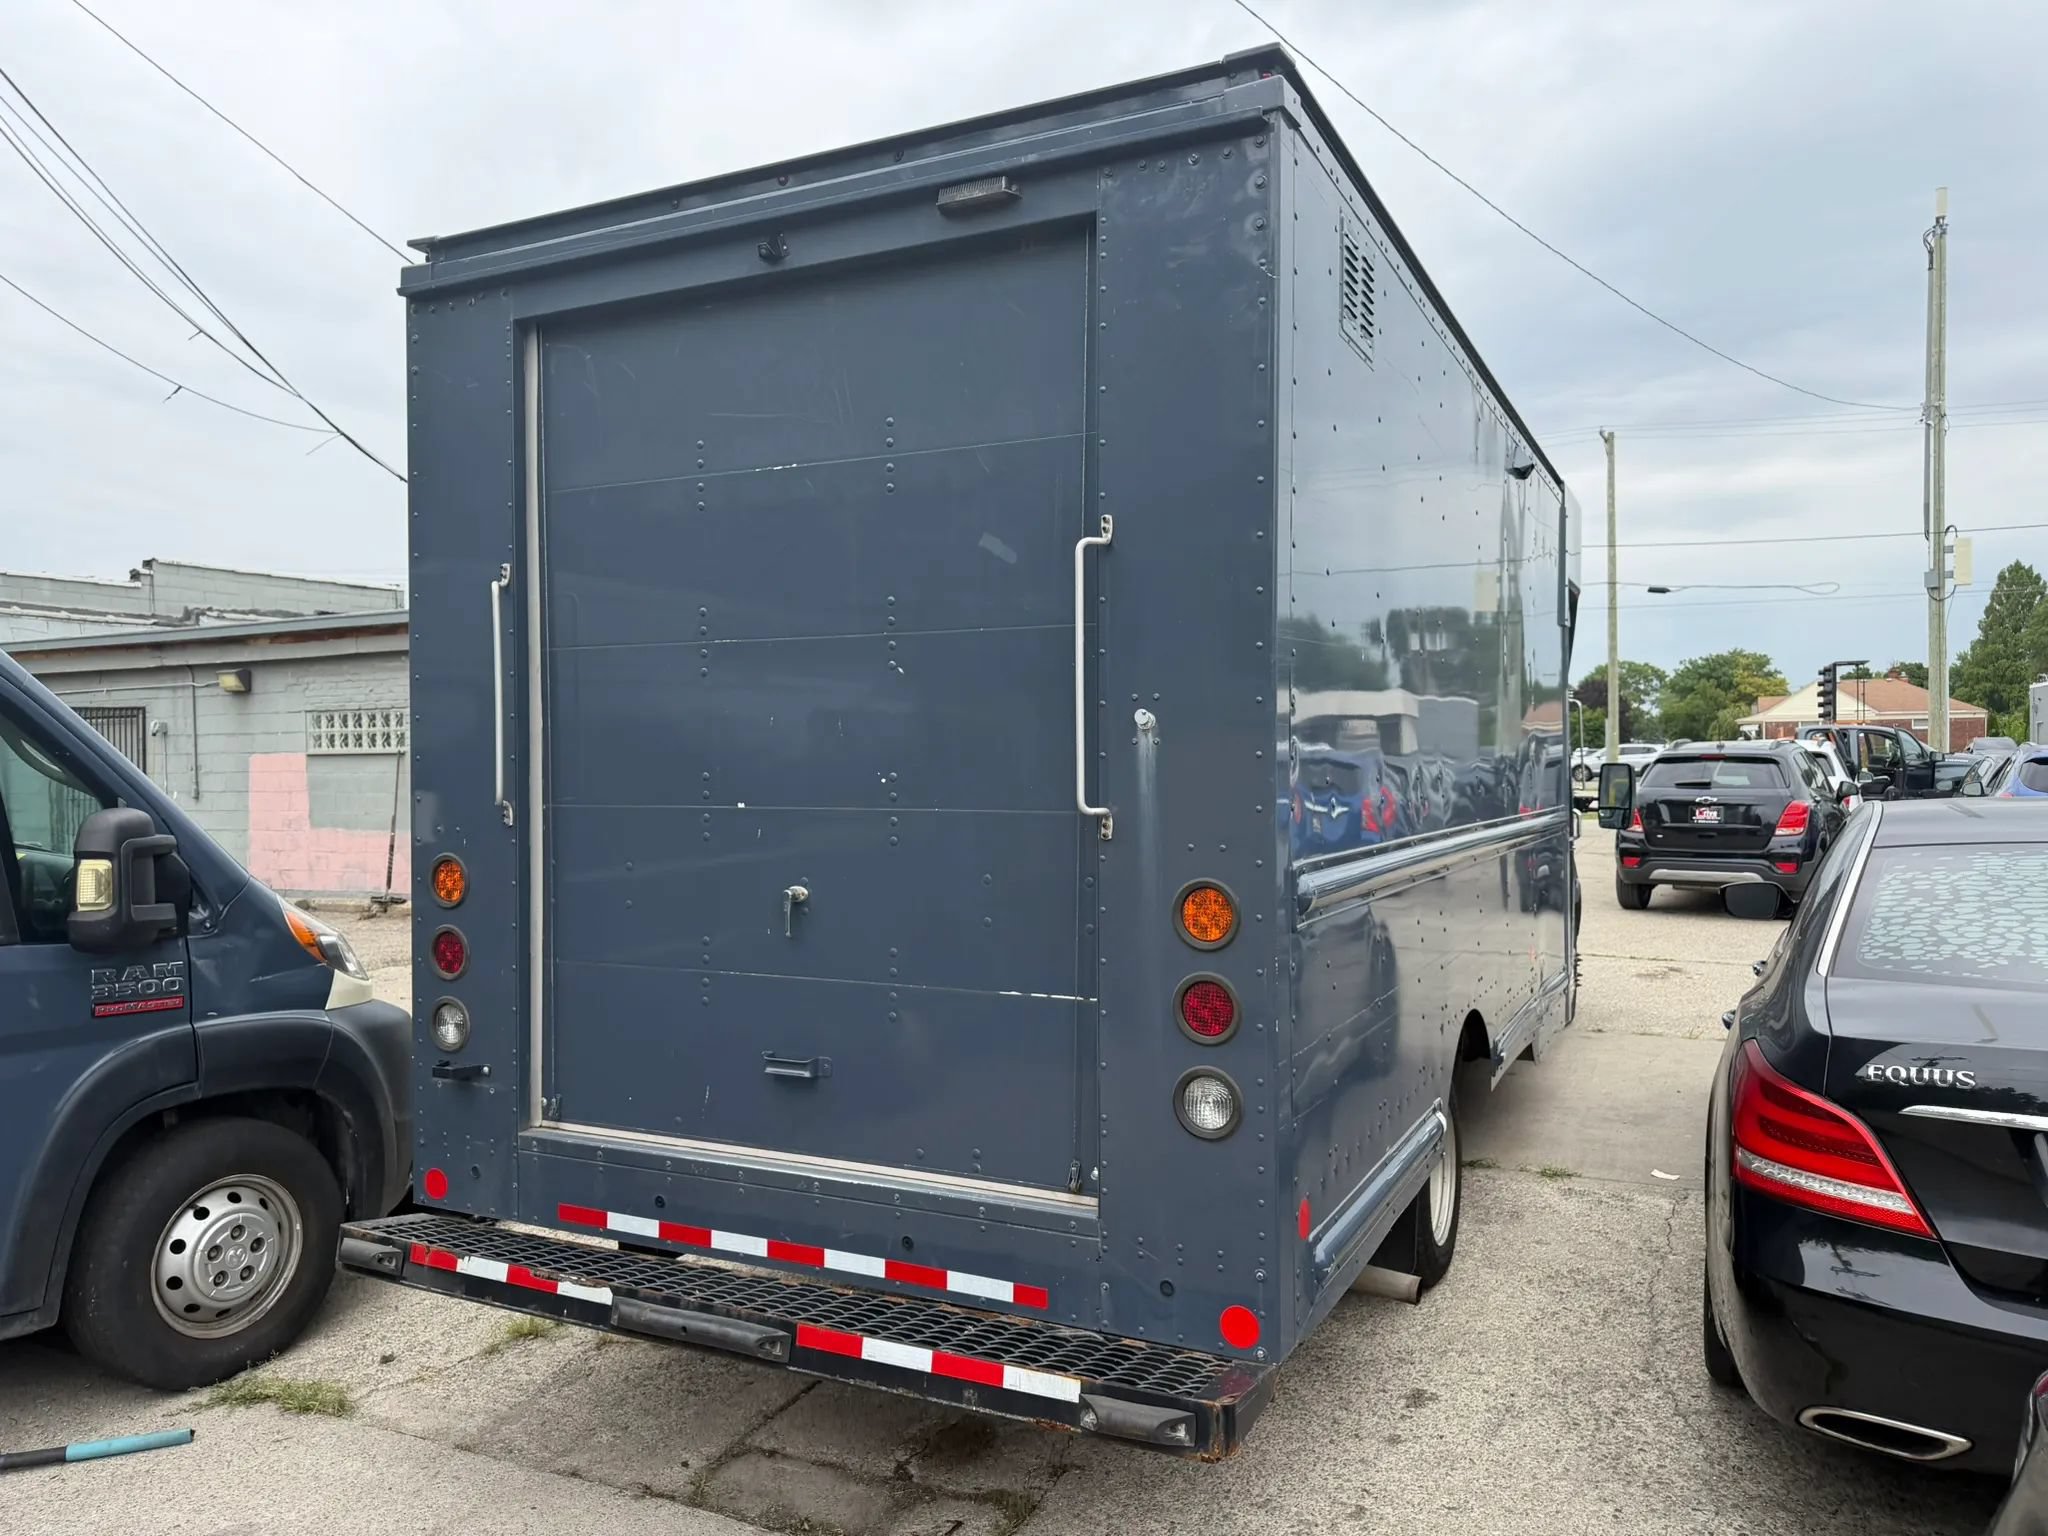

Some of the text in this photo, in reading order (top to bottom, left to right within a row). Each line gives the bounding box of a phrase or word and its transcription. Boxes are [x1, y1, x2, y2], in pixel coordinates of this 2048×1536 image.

[91, 961, 184, 984] RAM
[91, 977, 185, 999] 3500
[1867, 1064, 1977, 1089] EQUUS
